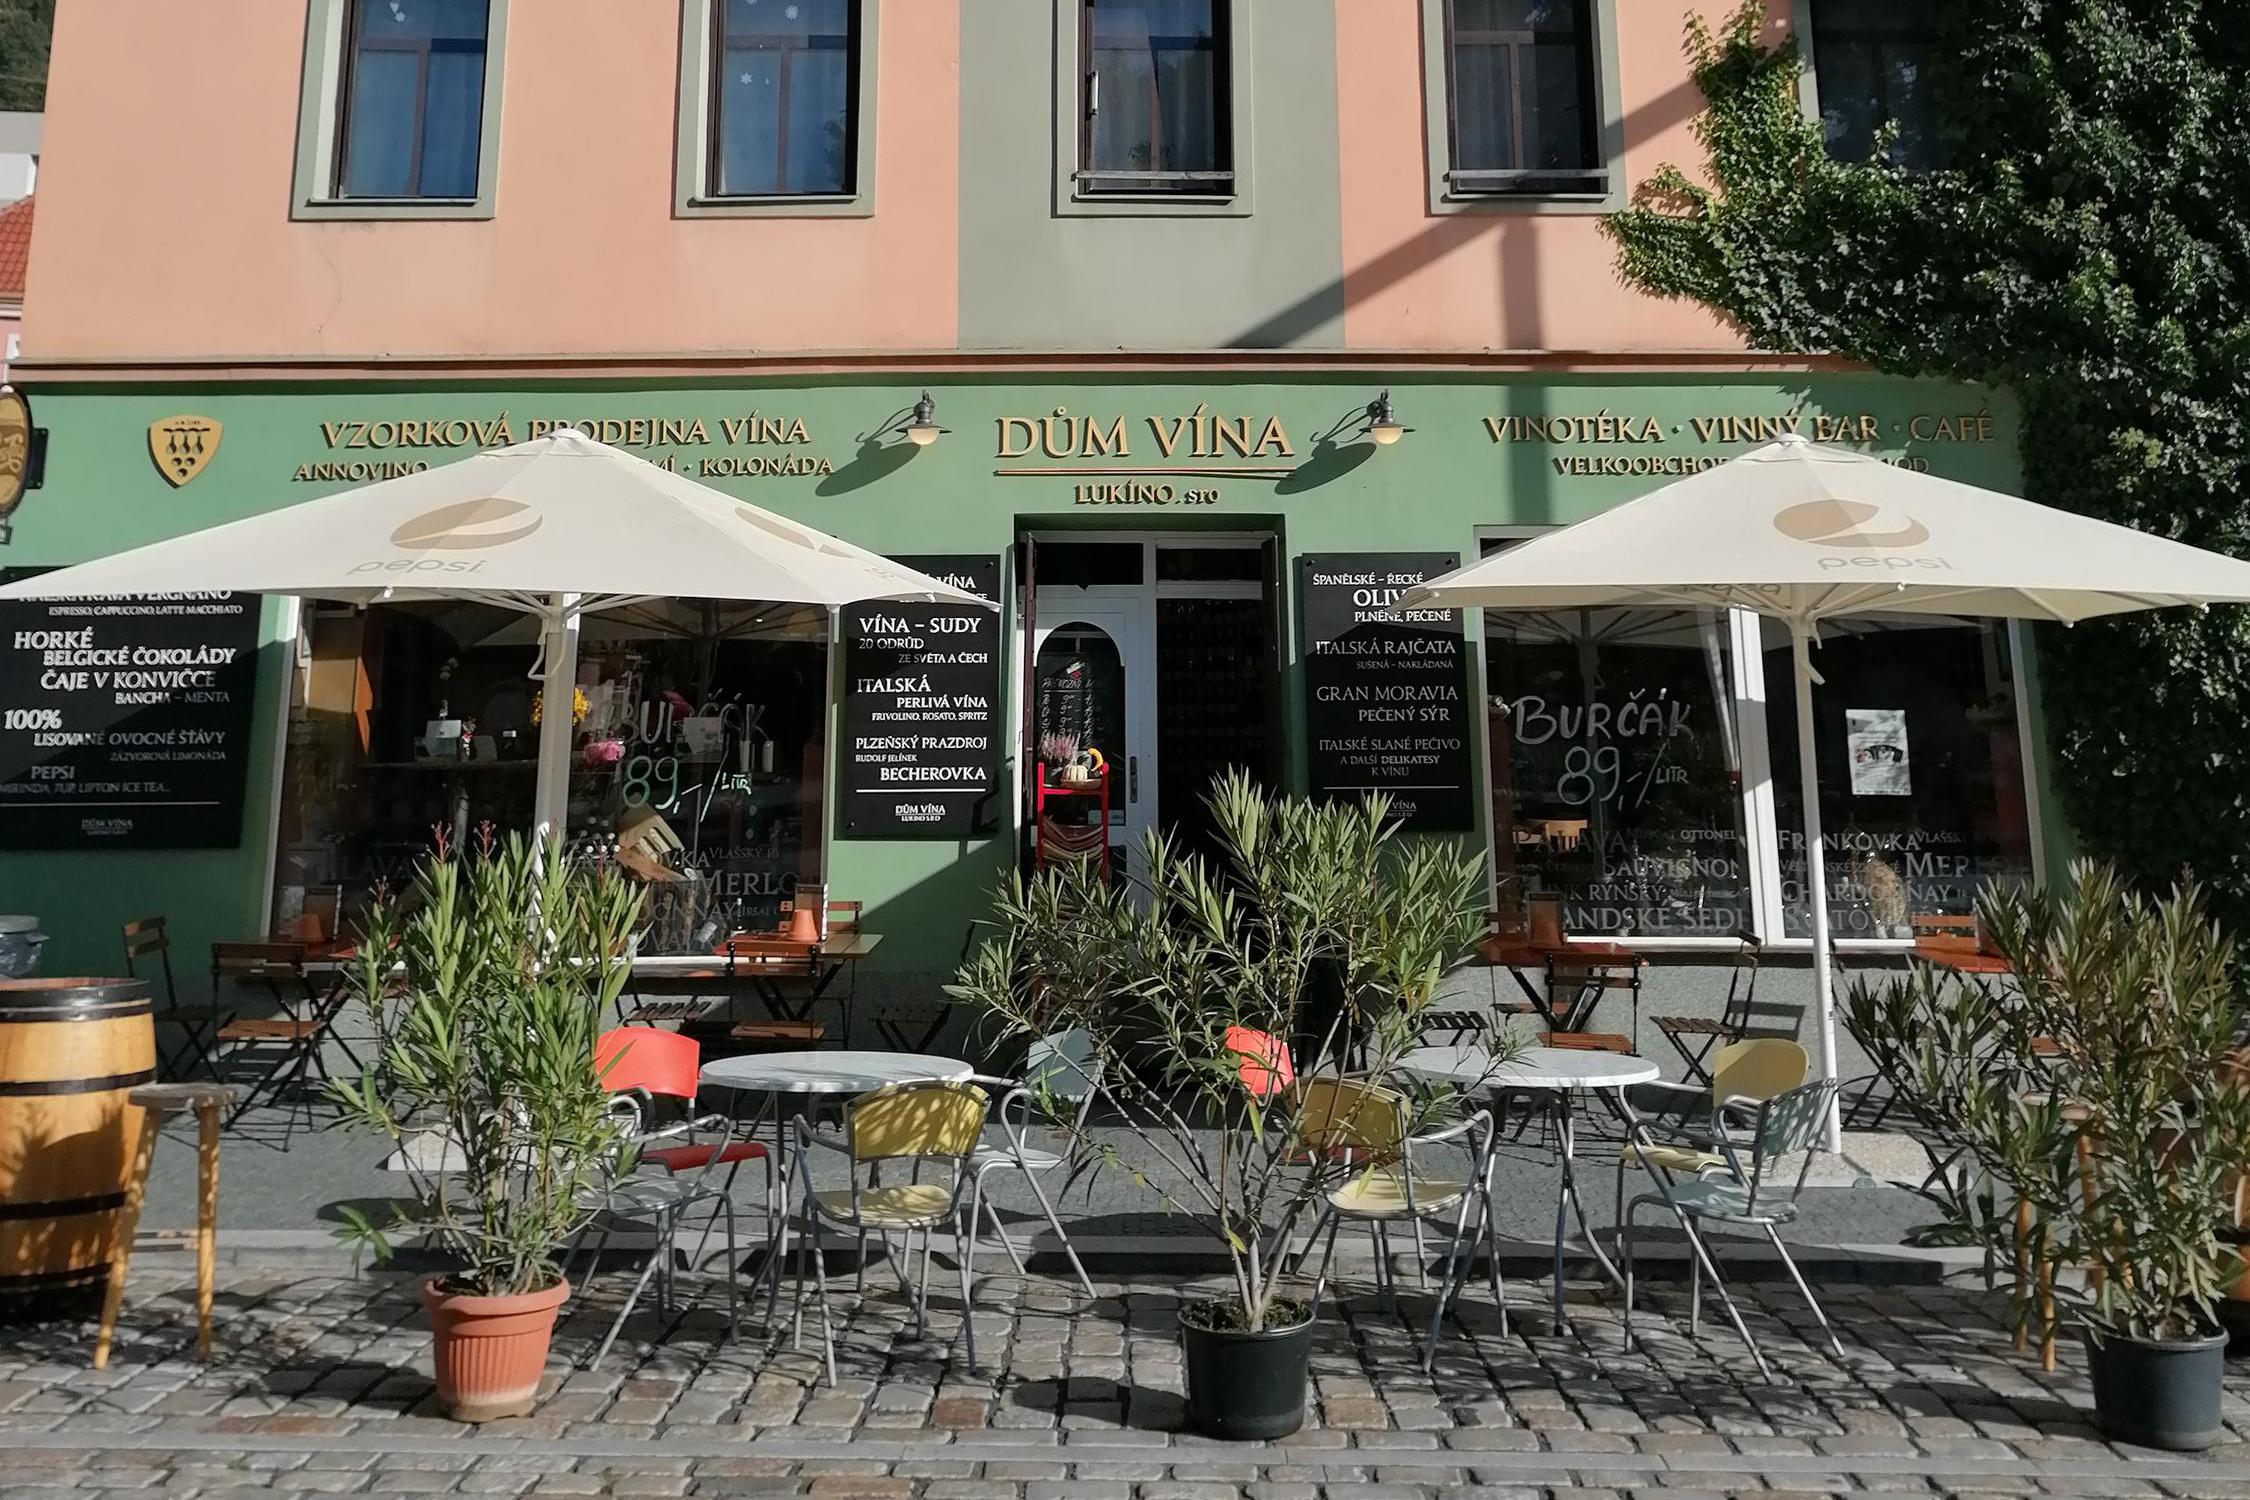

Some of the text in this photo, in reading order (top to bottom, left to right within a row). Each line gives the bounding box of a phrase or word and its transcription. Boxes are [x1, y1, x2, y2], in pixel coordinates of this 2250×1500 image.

[322, 411, 516, 449] VZORKOVÁ
[721, 409, 811, 446] VÍNA
[995, 402, 1295, 458] DŮM VÍNA
[1482, 407, 1995, 443] VINOTÉKA VINNÝ BAR CAFÉ
[700, 452, 835, 477] KOLONÁDA
[348, 556, 482, 577] pepsi
[1817, 556, 1952, 570] pepsi
[1312, 573, 1376, 585] ŠPANĚLSKÉ
[1387, 573, 1424, 585] ŘECKÉ
[859, 614, 911, 633] VÍNA
[930, 617, 982, 633] SUDY
[1406, 609, 1452, 622] PEČENÉ
[14, 627, 95, 649] HORKÉ
[858, 636, 924, 649] 20 ODRŮD
[1315, 638, 1456, 656] ITALSKÁ RAJČATA
[43, 645, 237, 667] BELGICKÉ ČOKOLÁDY
[898, 653, 912, 663] ZE
[947, 653, 957, 663] A
[958, 651, 988, 663] ČECH
[40, 668, 217, 692] ČAJE V KONVIČCE
[857, 675, 932, 693] ITALSKÁ
[114, 691, 171, 705] BANCHA
[184, 690, 231, 703] MENTA
[896, 694, 988, 709] PERLIVÁ VÍNA
[1316, 686, 1459, 701] GRAN MORAVIA
[3, 708, 63, 730] 100%
[958, 711, 988, 721] SPRITZ
[1358, 705, 1451, 721] PEČENÝ SÝR
[1511, 687, 1692, 744] BURČÁK
[33, 729, 227, 746] LISOVANÉ OVOCNÉ ŠŤÁVY
[855, 734, 988, 750] PLZEŇSKÝ PRAZDROJ
[1319, 736, 1461, 751] ITALSKÉ SLANÉ PEČIVO
[855, 752, 918, 763] RUDOLF JELÍNEK
[1381, 755, 1441, 764] DELIKATESY
[30, 766, 76, 780] PEPSI
[880, 767, 988, 781] BECHEROVKA
[895, 803, 946, 815] DŮM VÍNA
[1778, 829, 1922, 851] FRNKOVKA
